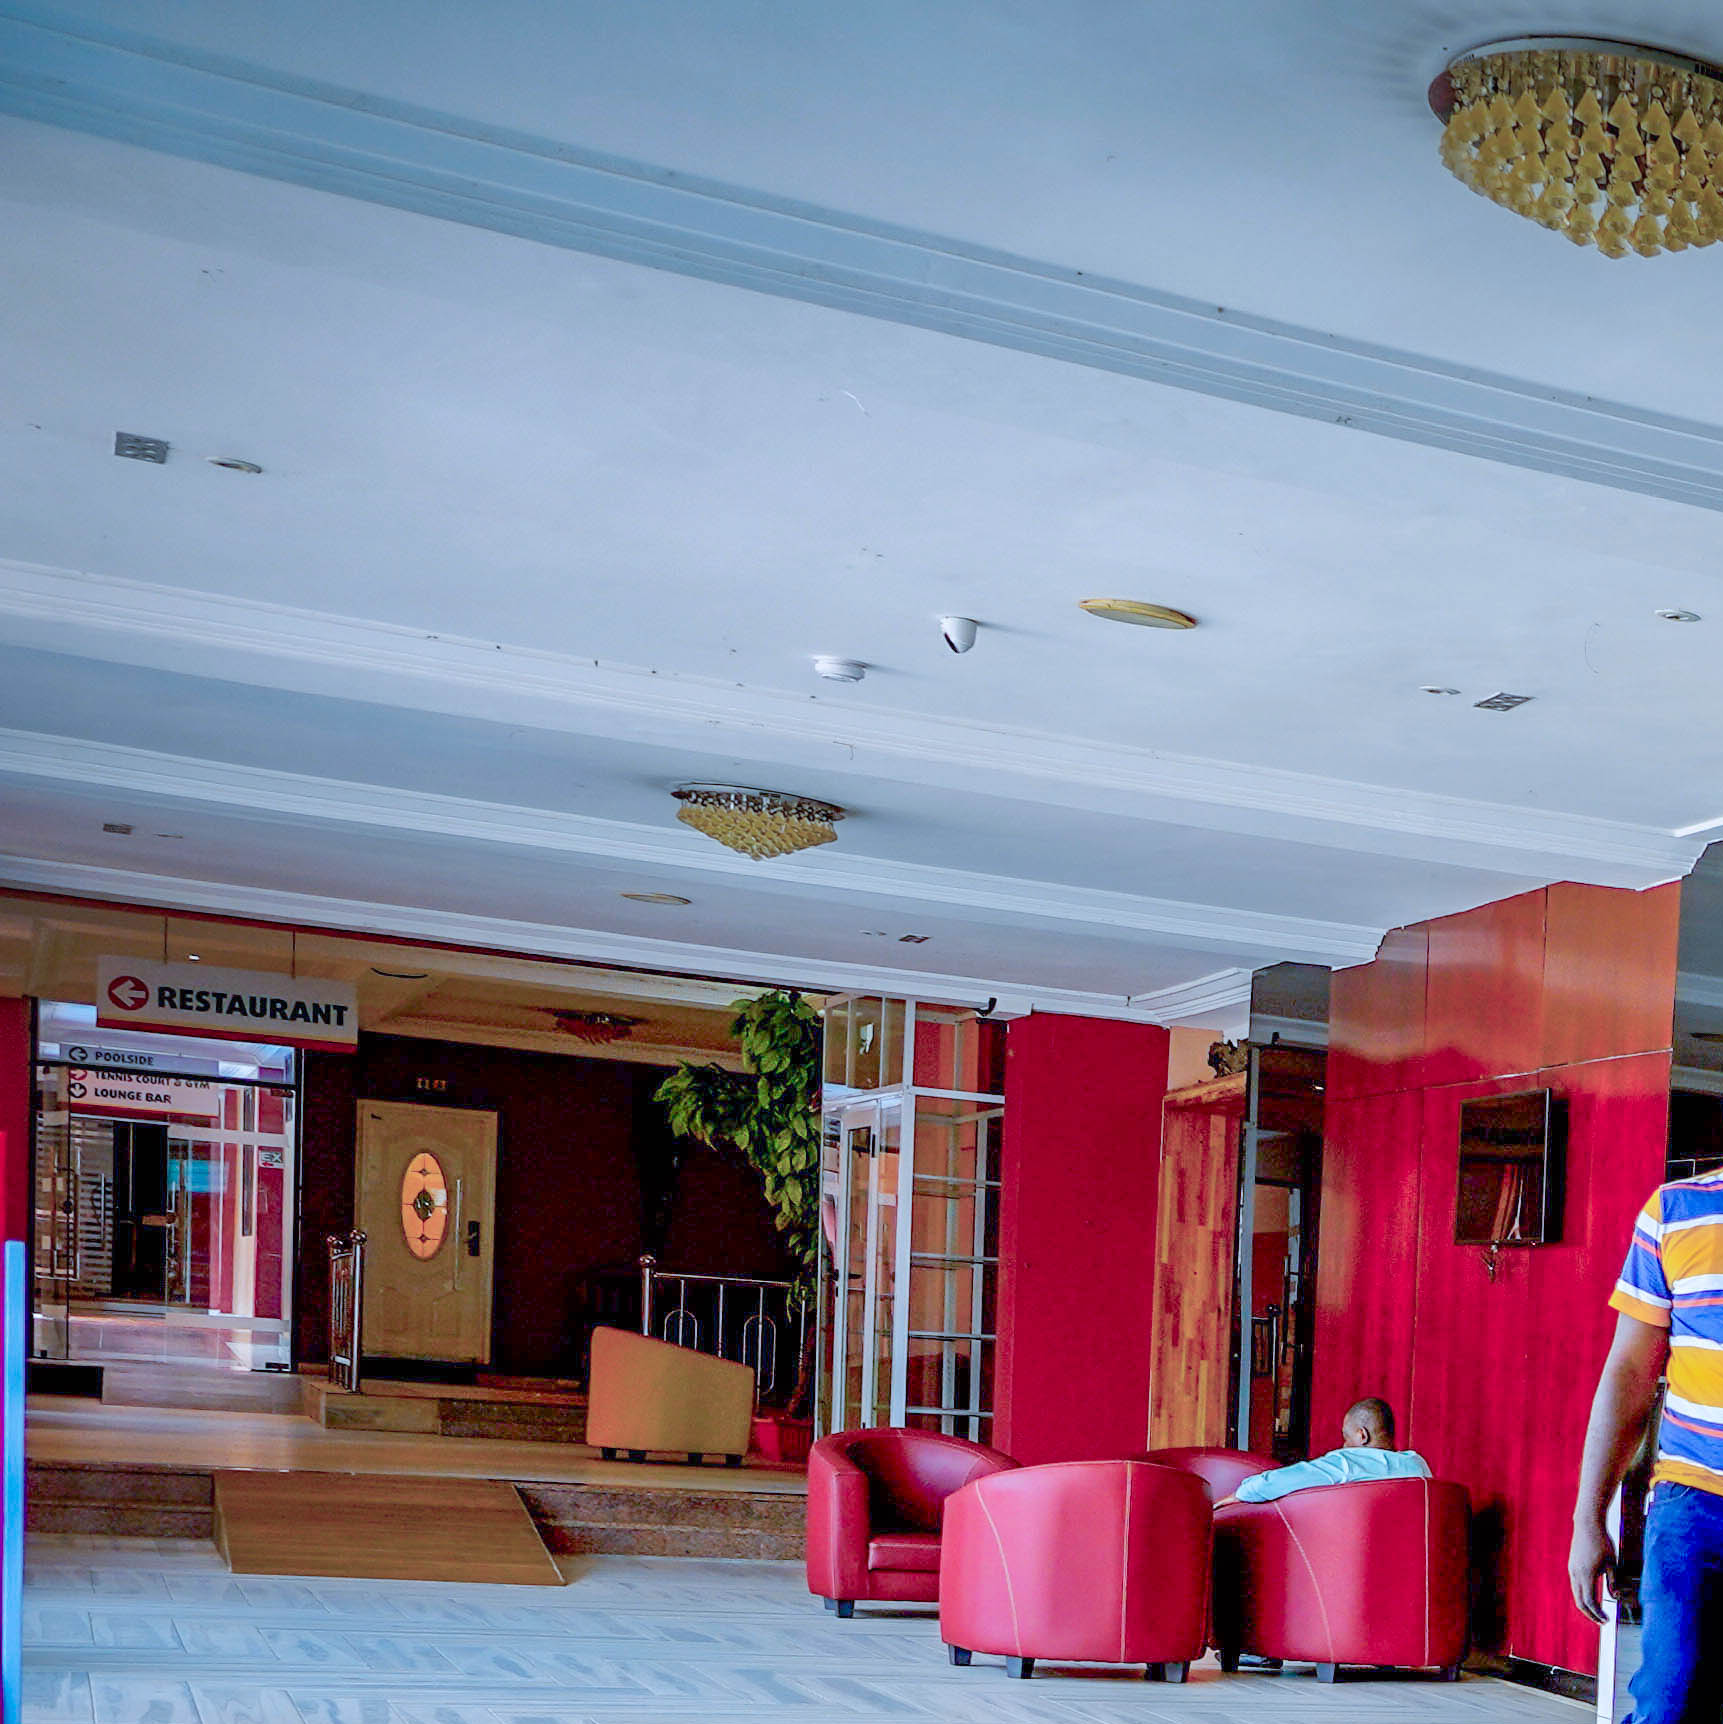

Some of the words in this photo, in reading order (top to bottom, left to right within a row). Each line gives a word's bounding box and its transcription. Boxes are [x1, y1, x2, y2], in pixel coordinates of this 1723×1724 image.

[157, 986, 349, 1027] RESTAURANT
[95, 1051, 154, 1066] POOLSIDE
[95, 1070, 133, 1083] TENNIS
[94, 1087, 142, 1101] LOUNGE
[145, 1093, 172, 1105] BAR
